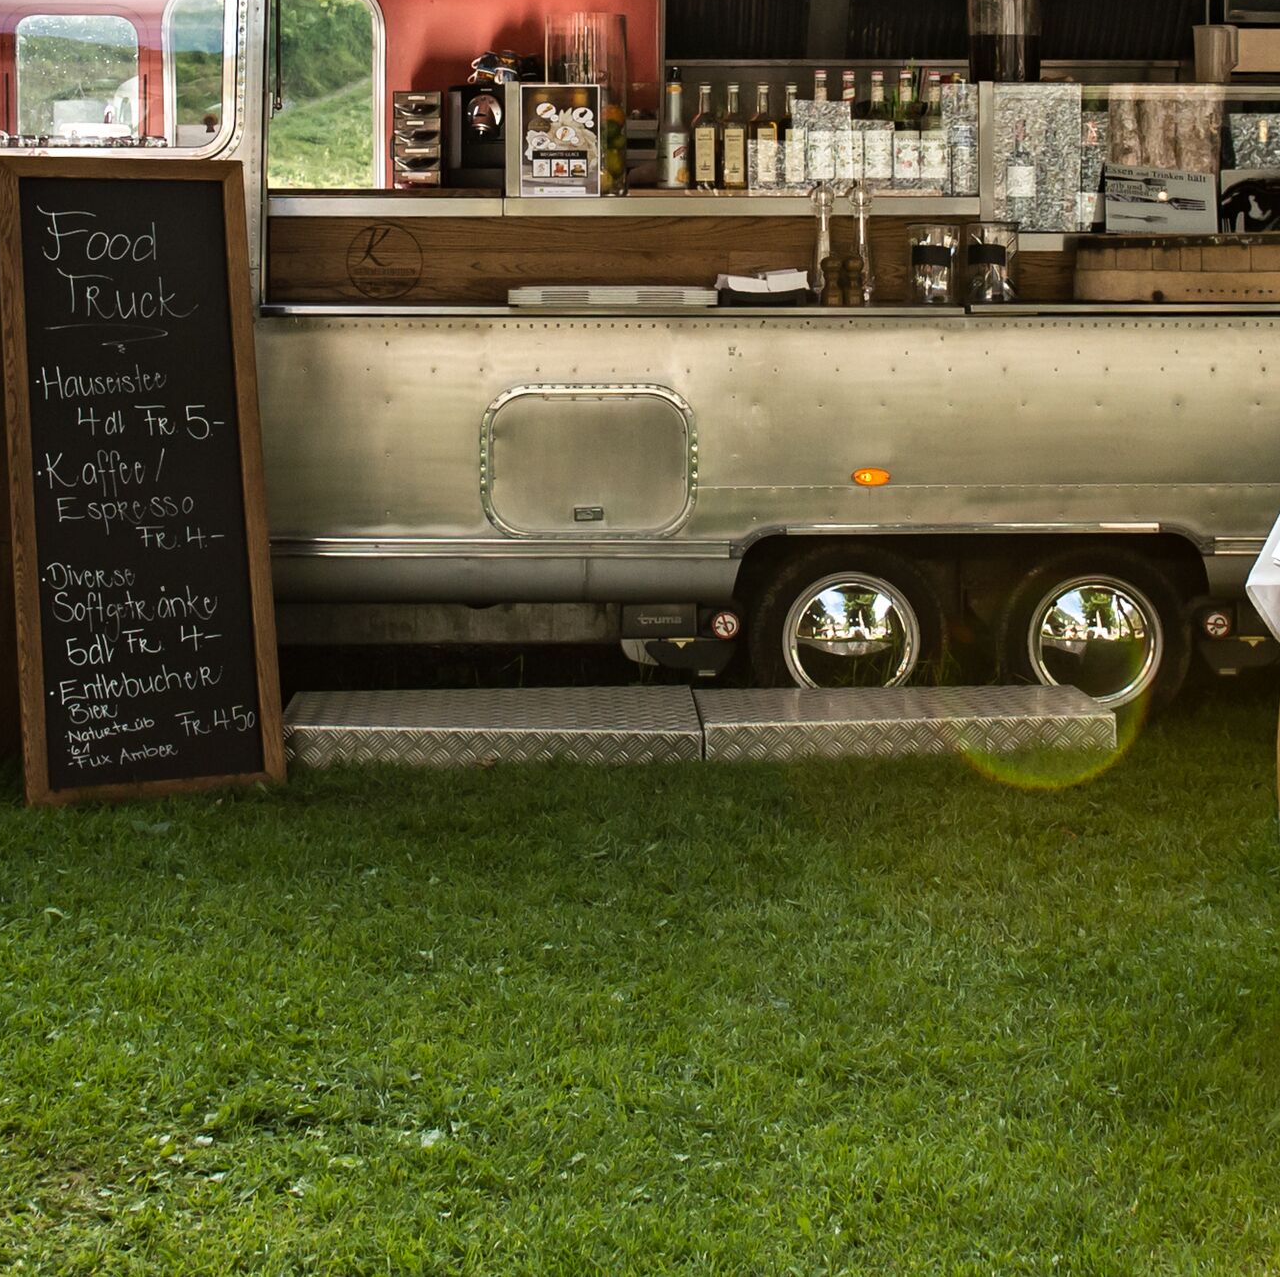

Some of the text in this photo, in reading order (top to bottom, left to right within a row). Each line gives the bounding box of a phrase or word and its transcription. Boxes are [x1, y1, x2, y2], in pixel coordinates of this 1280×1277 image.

[37, 205, 156, 261] Food
[42, 364, 167, 400] Hauseistee
[57, 496, 194, 536] Espresso
[46, 562, 136, 590] Diverse
[59, 664, 223, 705] Entlebucher
[68, 703, 118, 724] Bier
[120, 744, 179, 766] Amber
